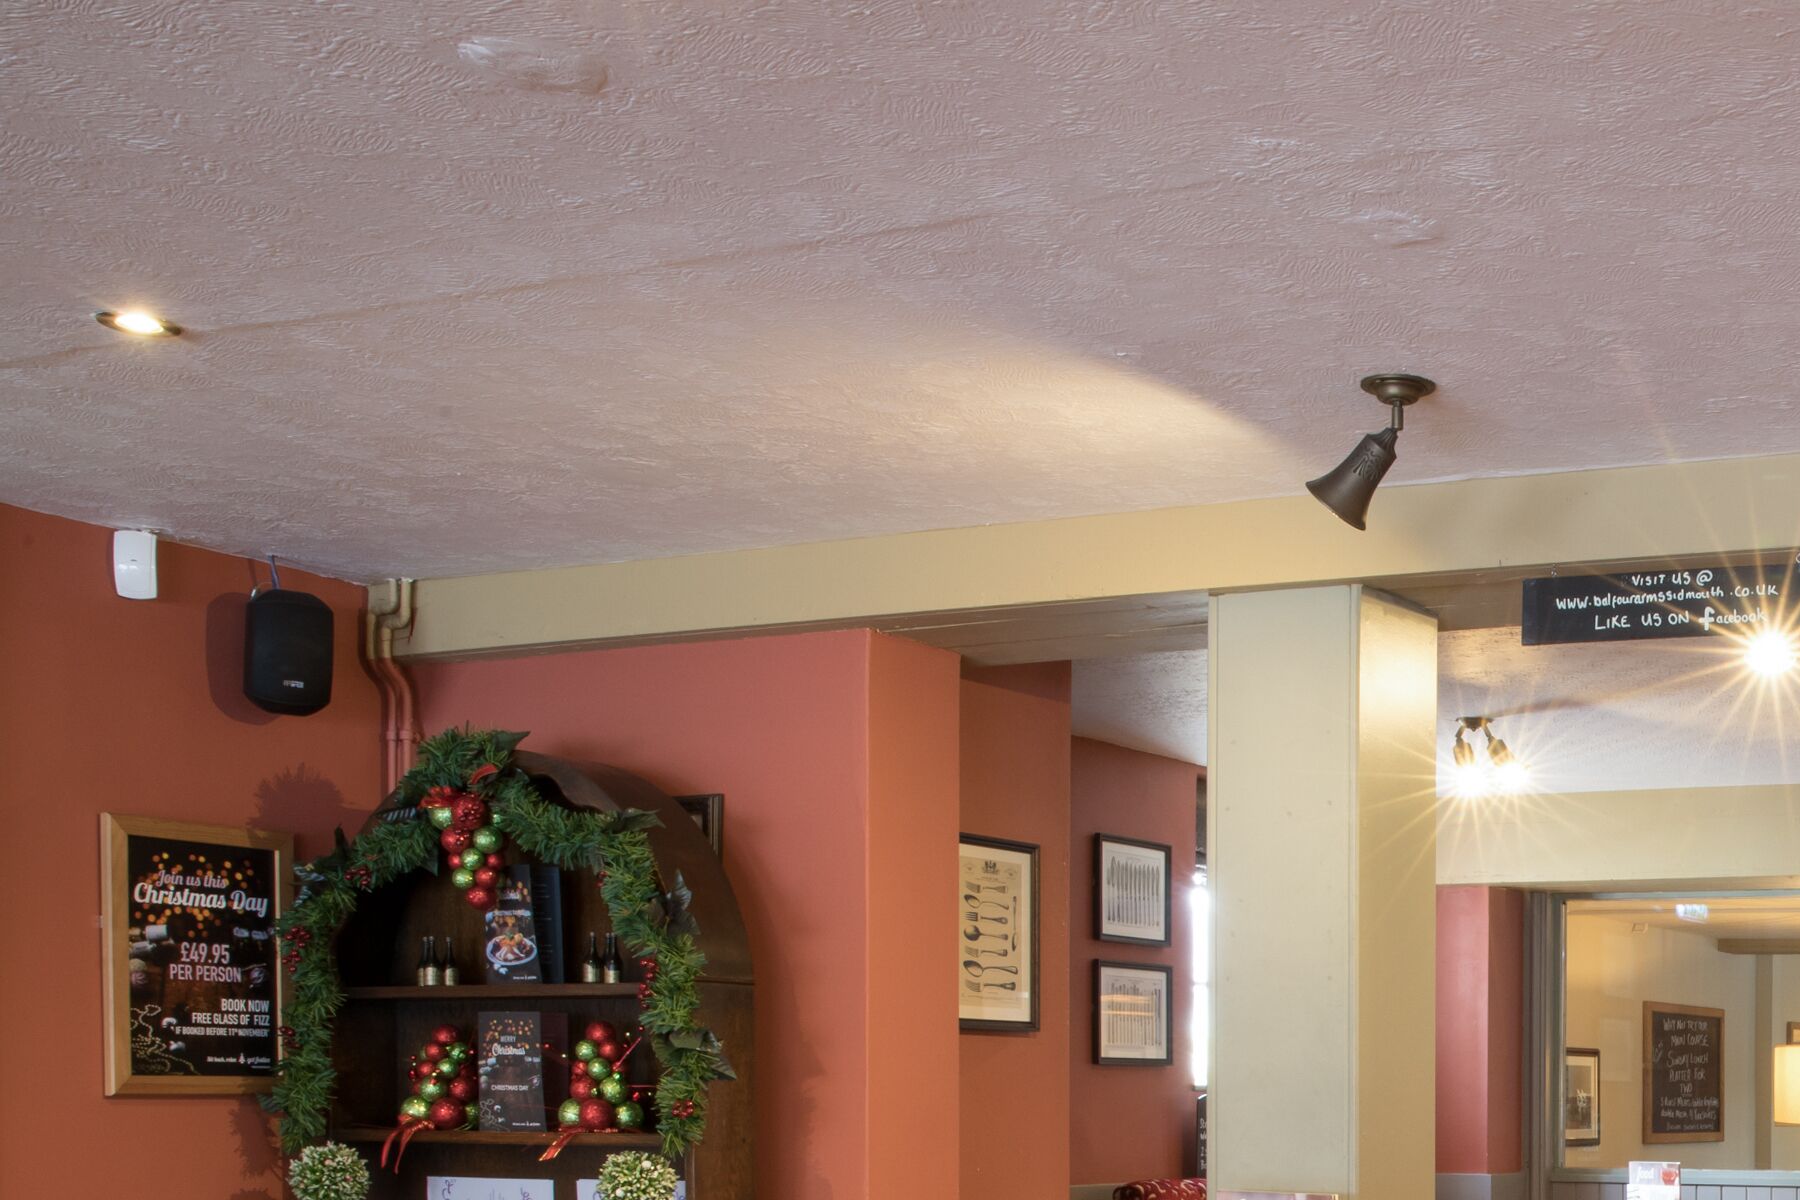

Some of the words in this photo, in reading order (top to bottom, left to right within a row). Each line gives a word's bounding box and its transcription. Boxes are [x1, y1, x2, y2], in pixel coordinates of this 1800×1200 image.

[1632, 573, 1665, 586] VISIT
[1672, 572, 1691, 585] US
[1594, 614, 1631, 631] LIKE
[1641, 614, 1662, 627] US
[1668, 611, 1689, 626] ON
[155, 870, 184, 887] Join
[186, 875, 201, 886] us
[203, 875, 226, 889] this
[134, 882, 226, 909] Christmas
[231, 890, 268, 918] Day
[180, 941, 230, 964] £49.95
[169, 963, 193, 980] PER
[195, 965, 242, 982] PERSON
[221, 999, 246, 1012] BOOK
[248, 1000, 270, 1012] NOW
[192, 1013, 212, 1024] FREE
[213, 1013, 239, 1025] GLASS
[240, 1014, 251, 1025] OF
[253, 1014, 270, 1026] FIZZ
